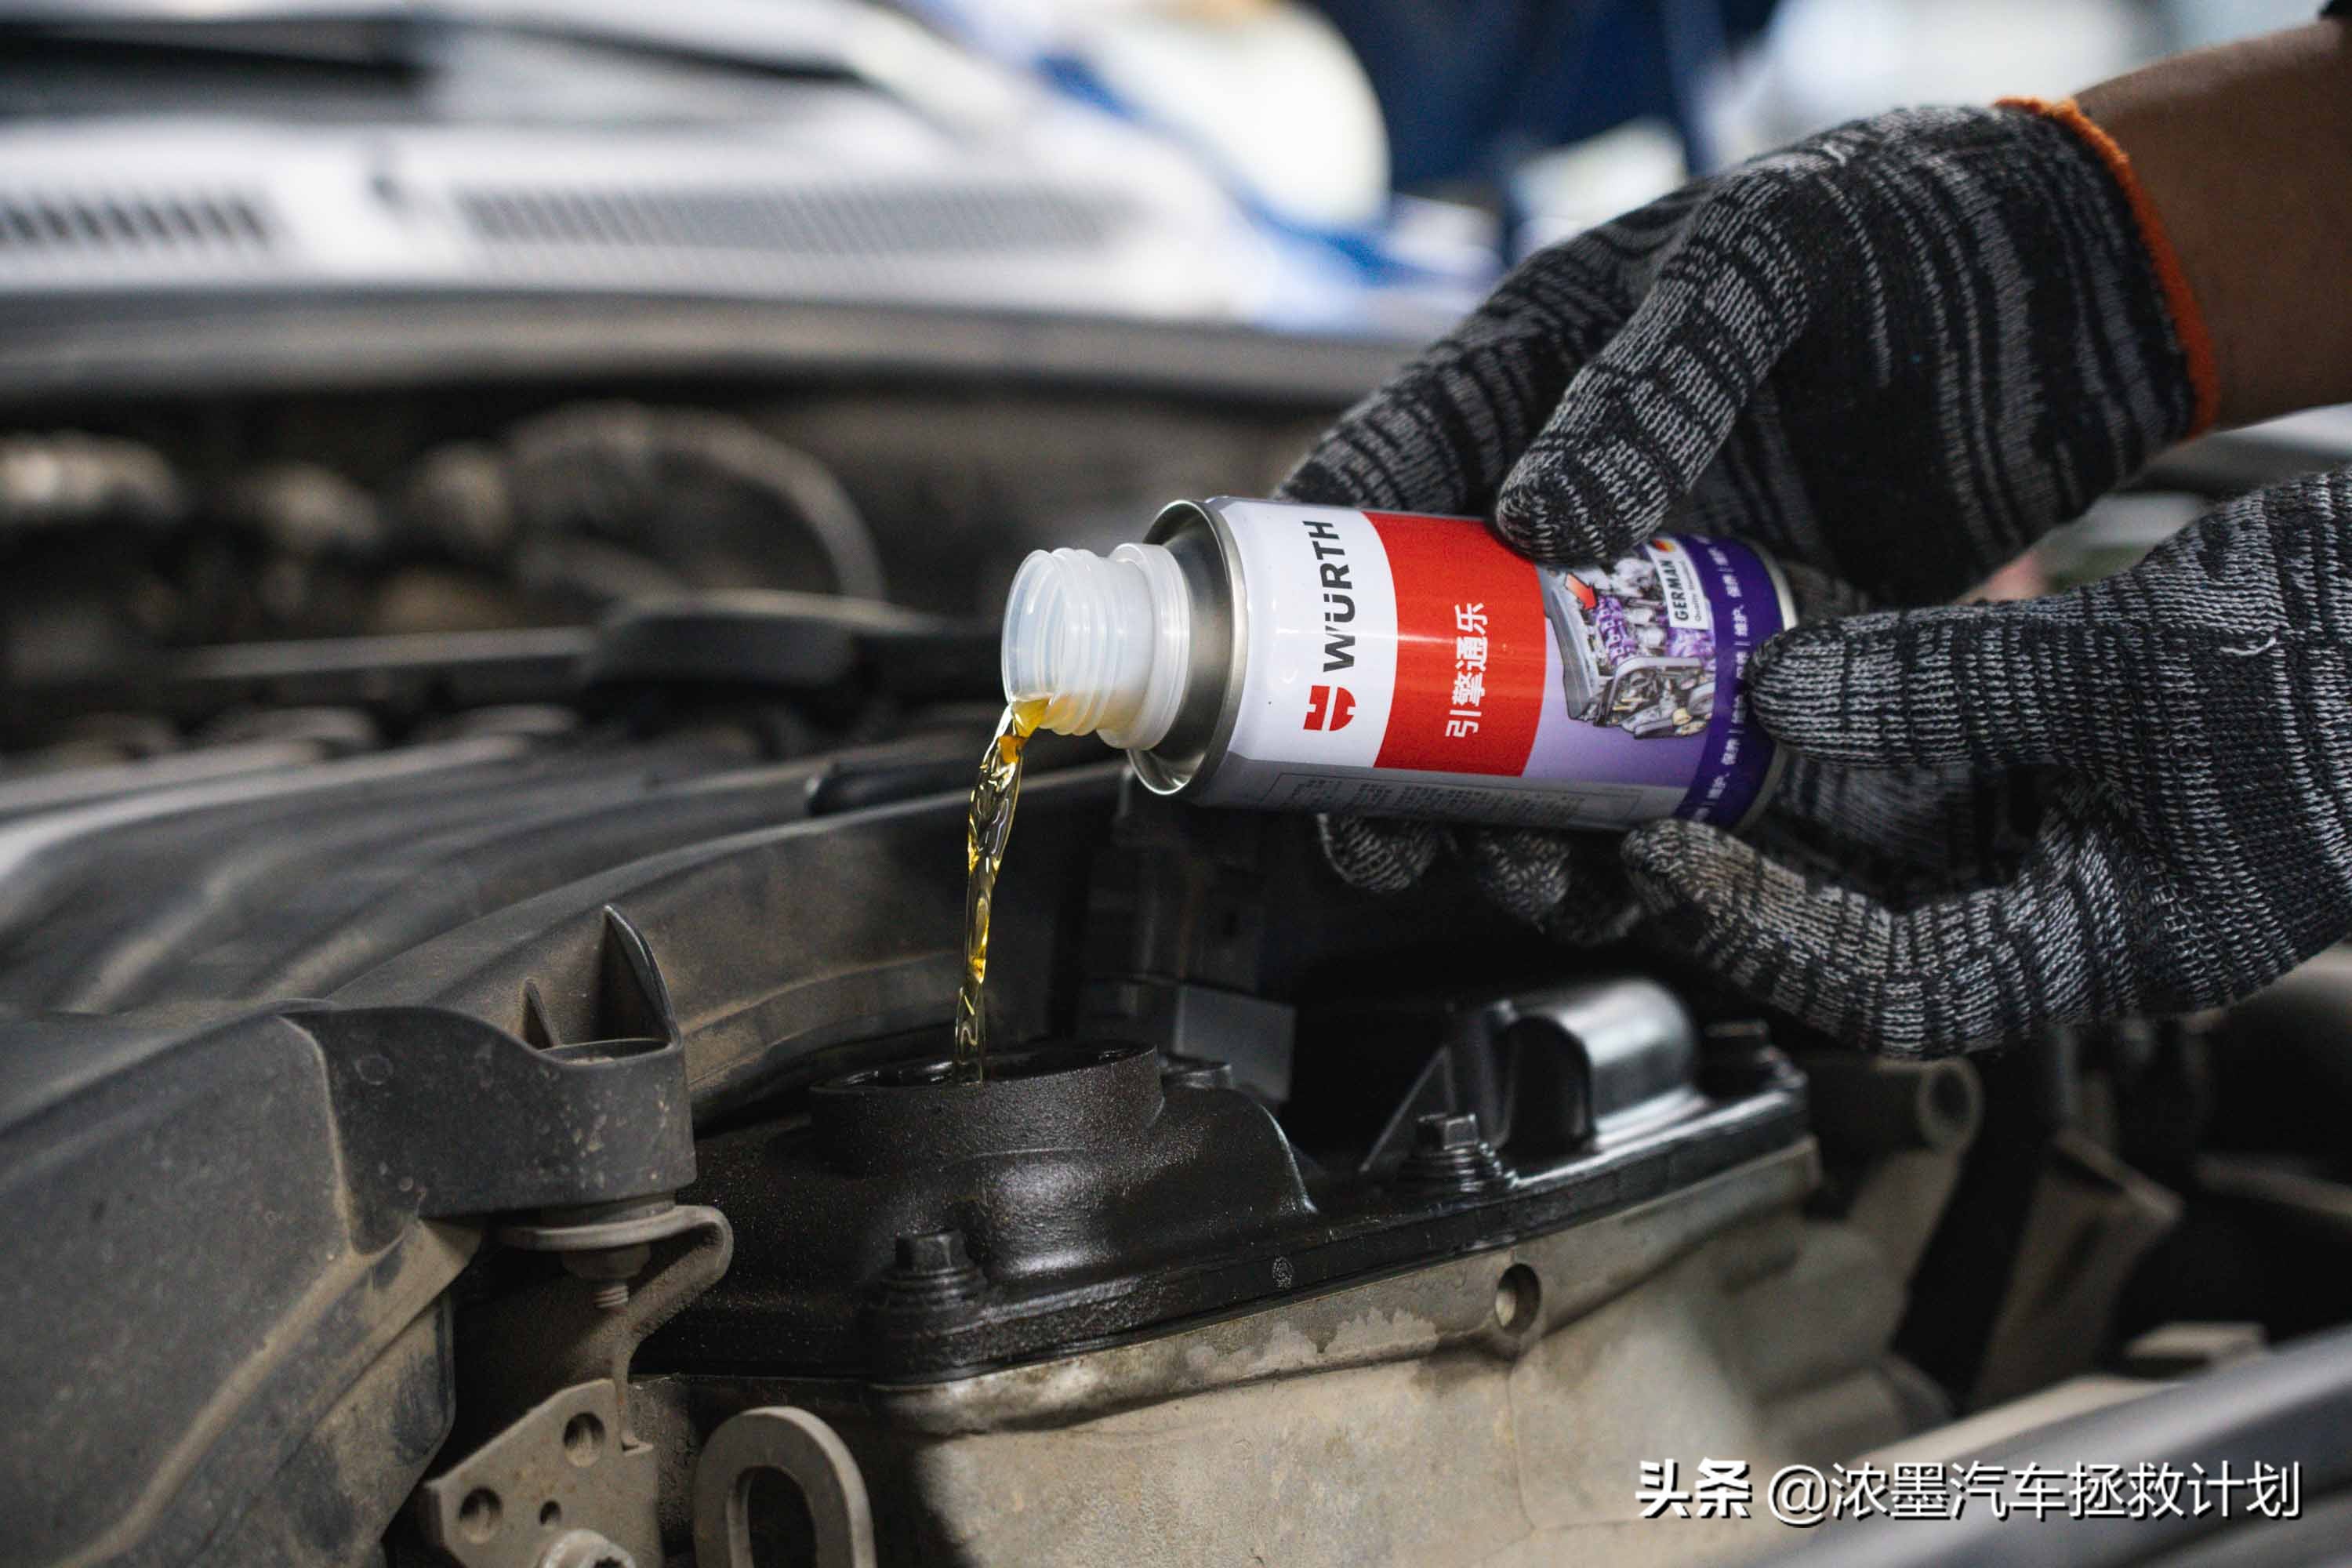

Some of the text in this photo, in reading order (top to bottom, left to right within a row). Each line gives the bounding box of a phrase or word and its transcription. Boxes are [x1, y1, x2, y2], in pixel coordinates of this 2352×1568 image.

[1302, 520, 1356, 673] WÜRTH
[1659, 559, 1689, 621] GERMAN
[1691, 593, 1702, 622] Quality
[1445, 602, 1488, 738] 引擎通乐
